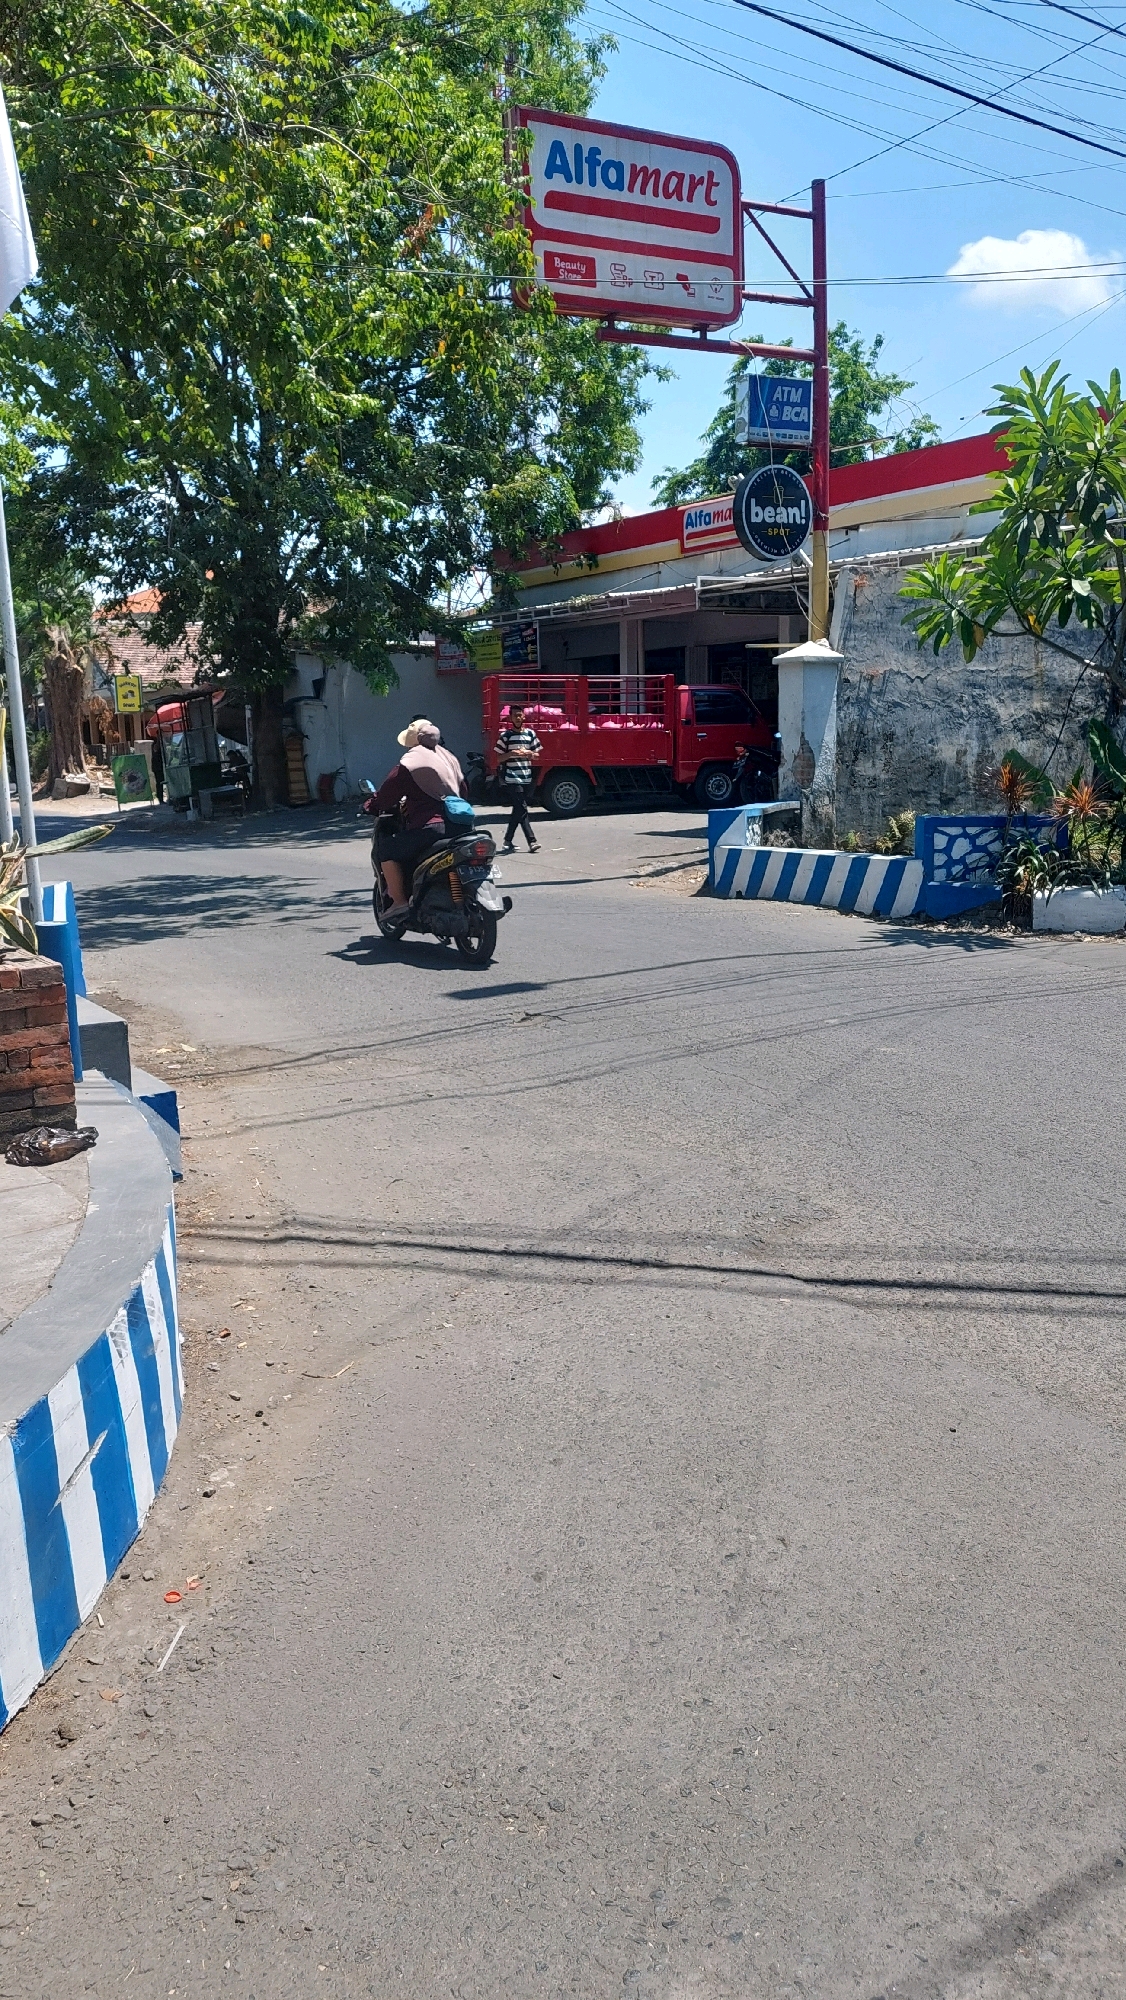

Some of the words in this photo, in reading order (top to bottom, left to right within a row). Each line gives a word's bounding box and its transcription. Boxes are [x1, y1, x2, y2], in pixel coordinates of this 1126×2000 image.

[544, 139, 720, 207] Alfamart
[553, 256, 587, 273] Beauty
[558, 268, 582, 280] Store
[773, 386, 802, 403] ATM
[781, 405, 809, 423] BCA
[685, 507, 734, 530] Alfama
[750, 497, 807, 525] bean!
[767, 527, 791, 536] SPOT
